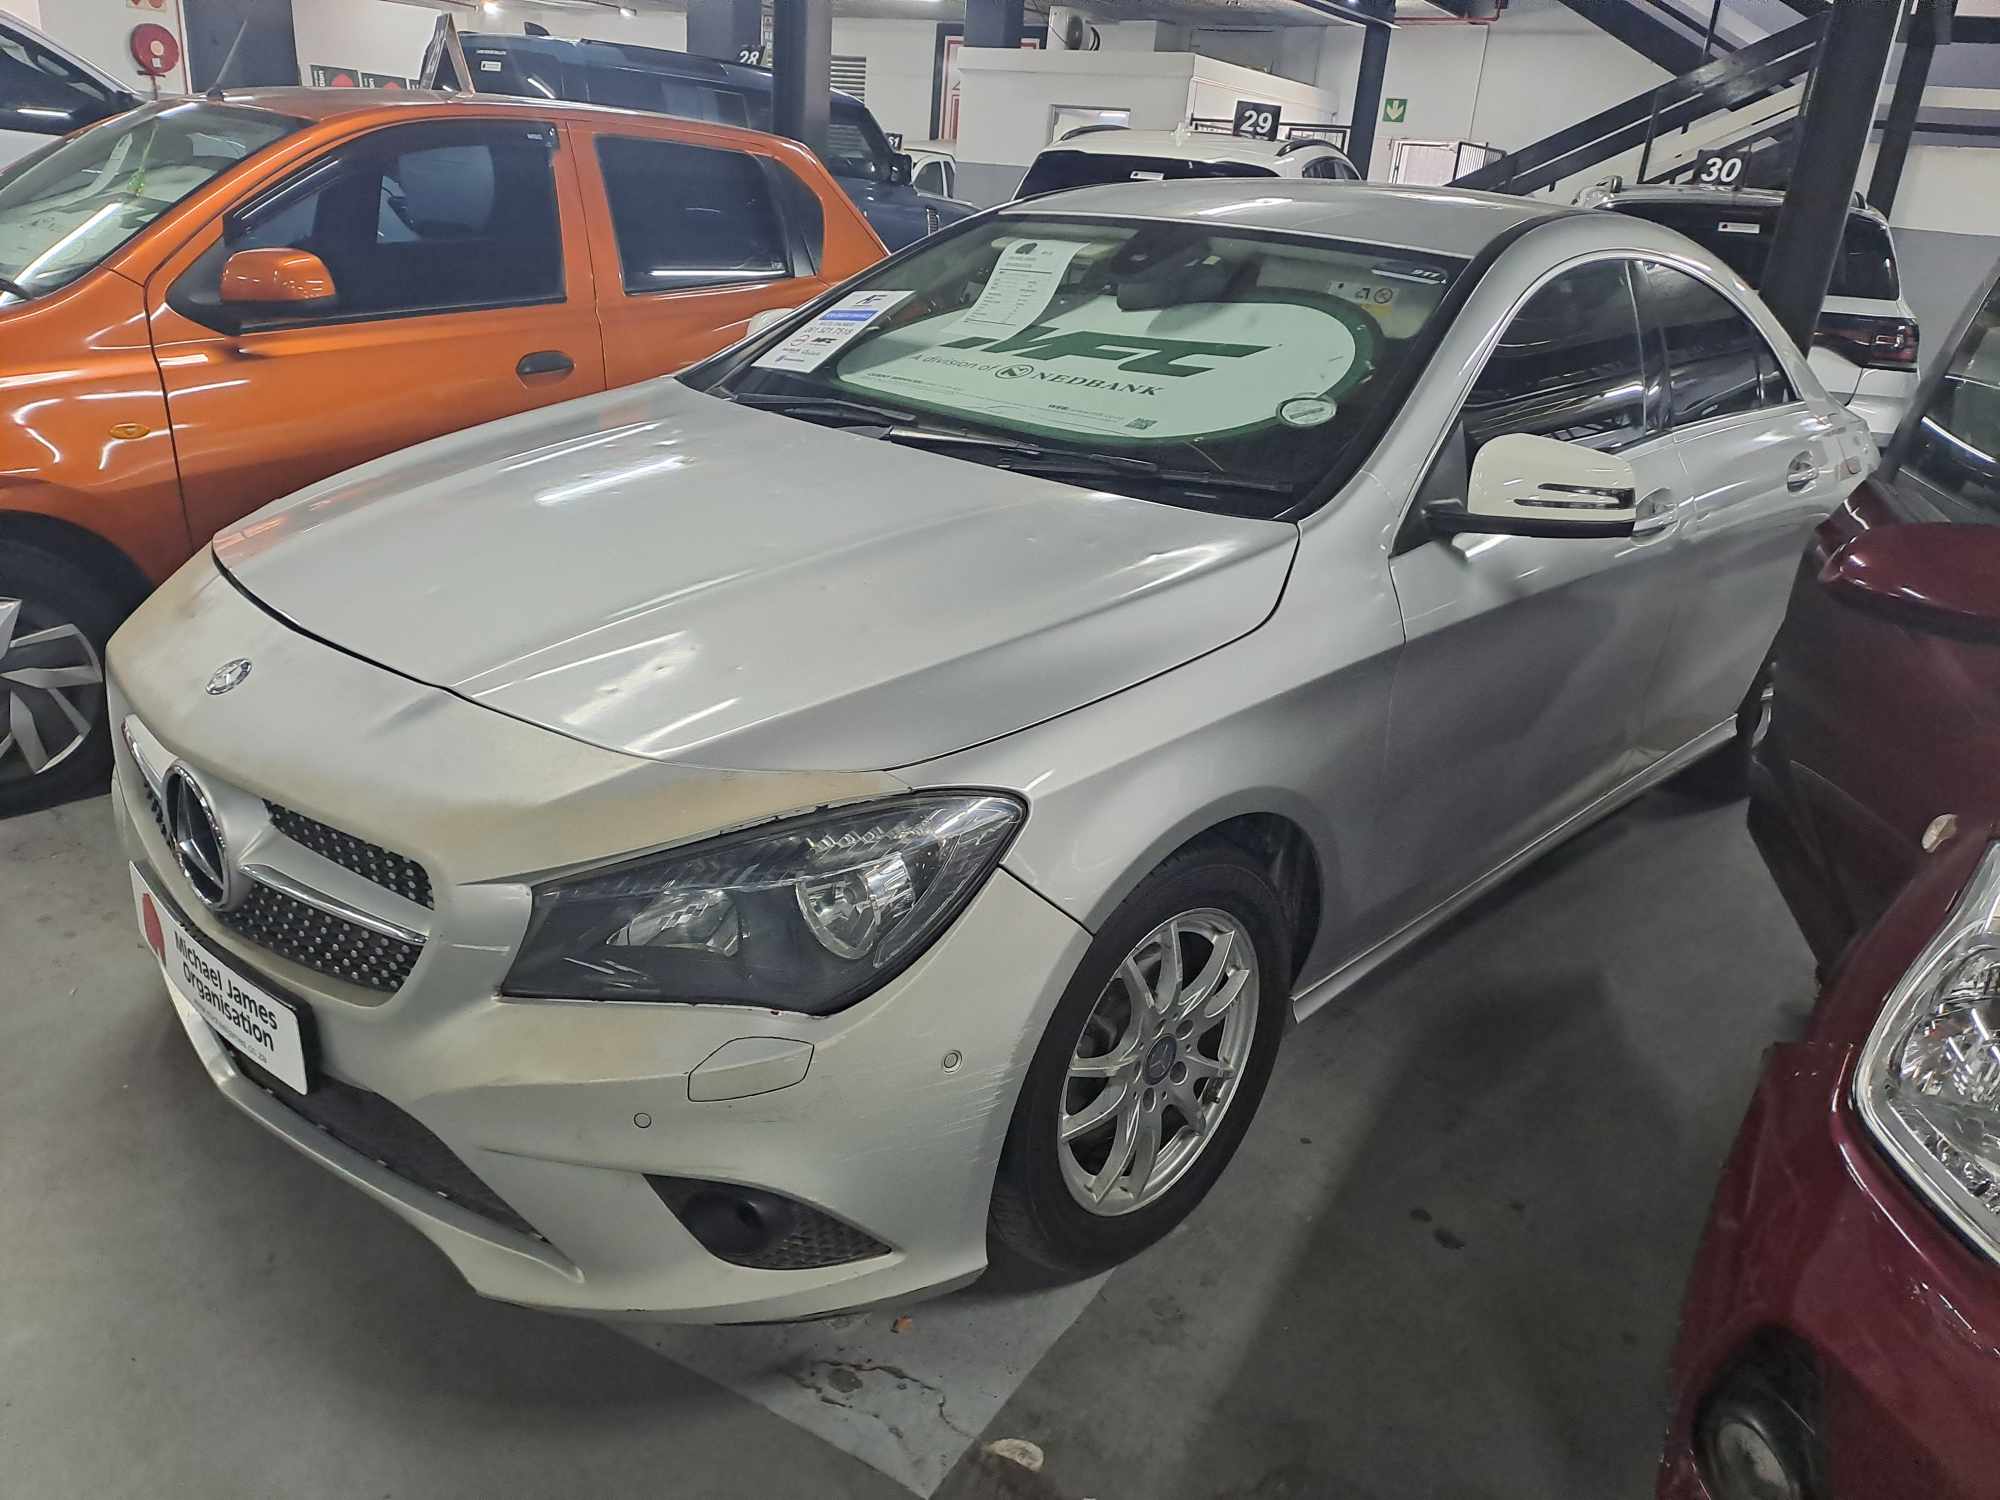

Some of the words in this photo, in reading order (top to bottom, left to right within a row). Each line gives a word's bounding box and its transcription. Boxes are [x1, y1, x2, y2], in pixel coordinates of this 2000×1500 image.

[740, 50, 759, 64] 28
[1241, 110, 1272, 133] 29
[1701, 157, 1742, 182] 30
[922, 354, 978, 370] division
[1031, 371, 1166, 396] NEDBANK
[174, 931, 222, 991] Michael
[227, 978, 278, 1030] James
[183, 961, 275, 1052] Organisation
